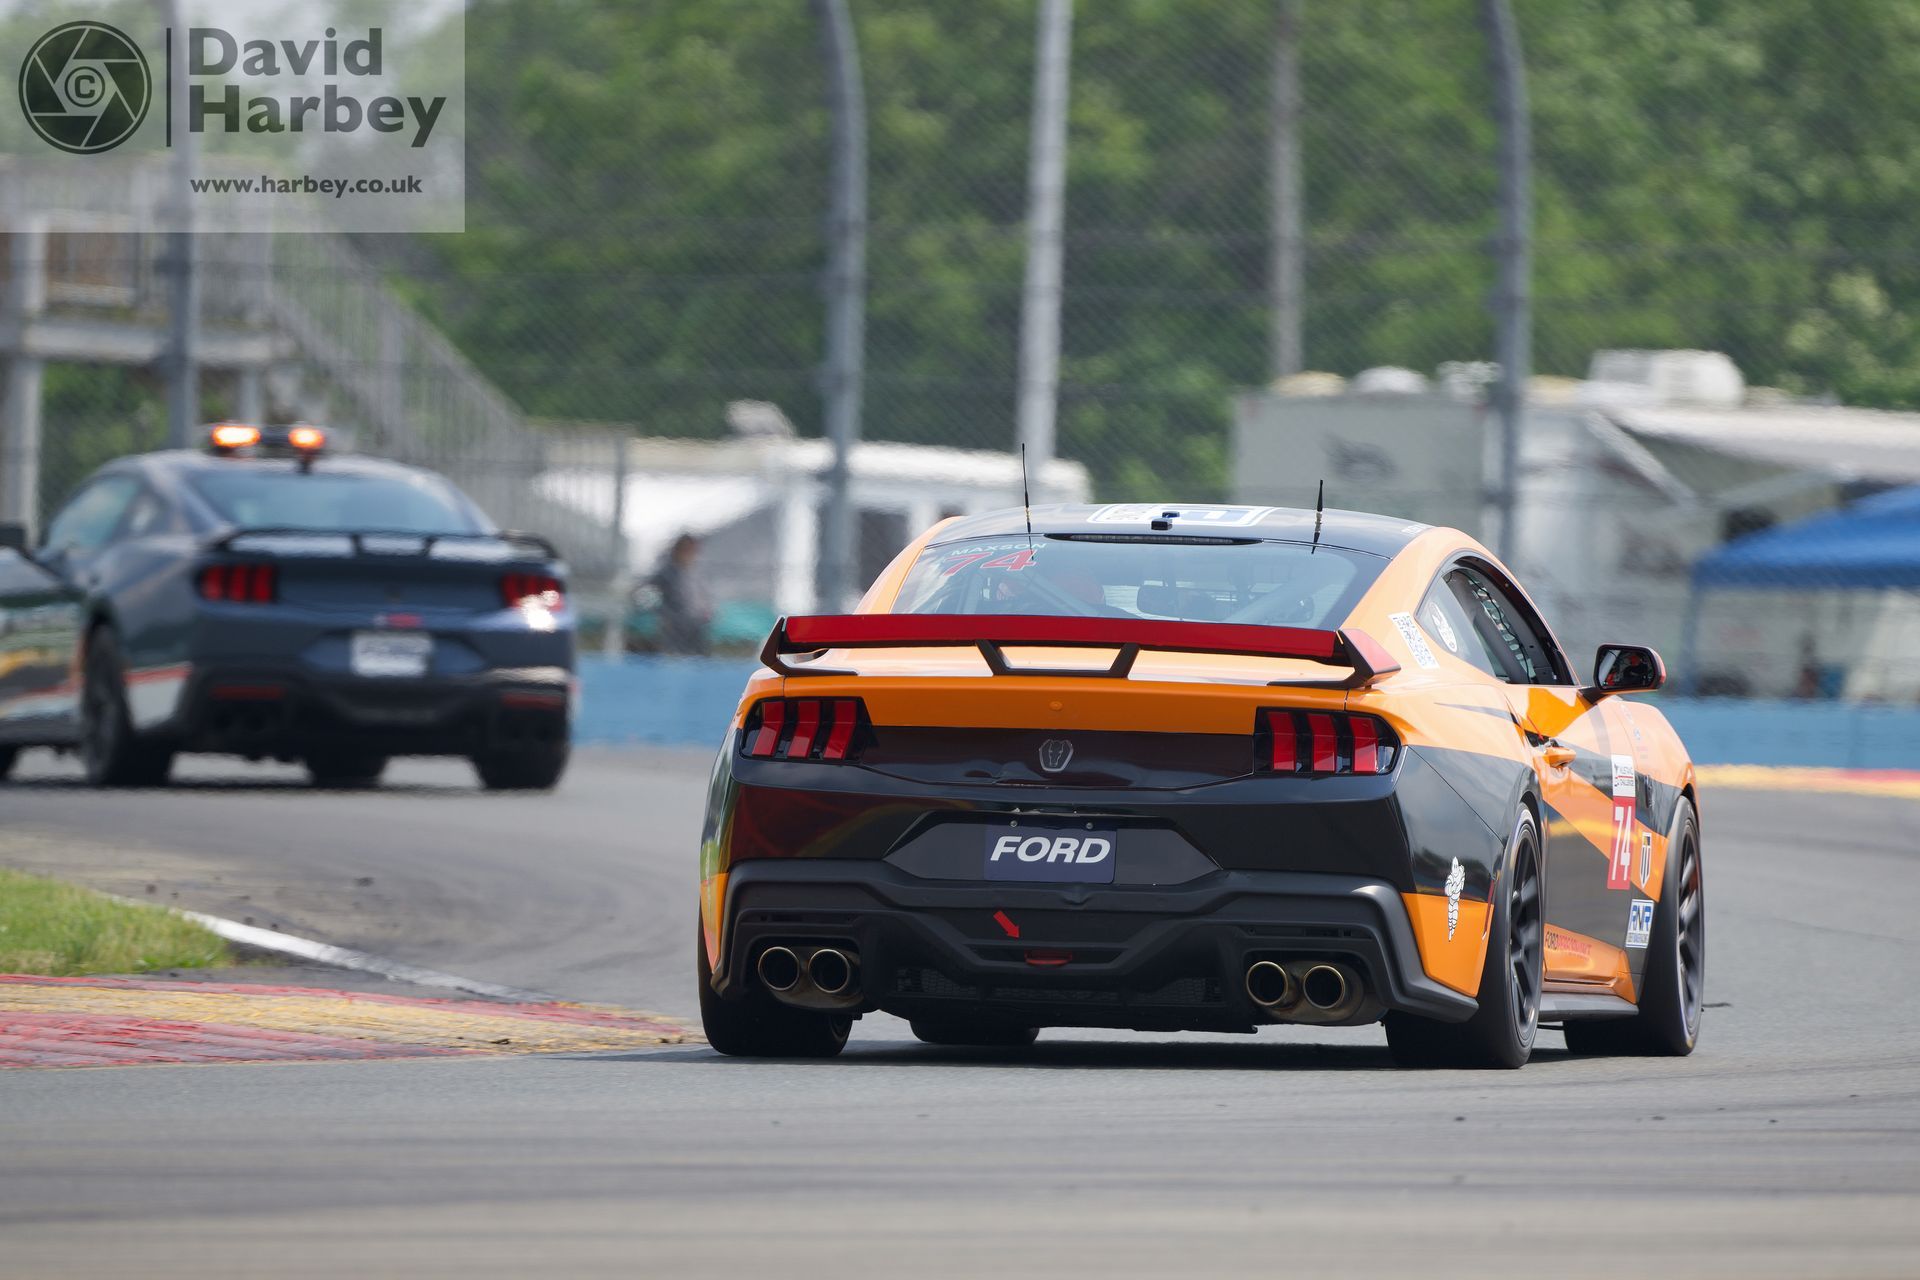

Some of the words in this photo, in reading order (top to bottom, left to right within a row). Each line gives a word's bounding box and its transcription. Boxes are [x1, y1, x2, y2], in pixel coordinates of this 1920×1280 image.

[951, 542, 1047, 556] MAXSON
[939, 550, 1038, 577] 74
[990, 836, 1111, 864] FORD
[1611, 806, 1632, 881] 74
